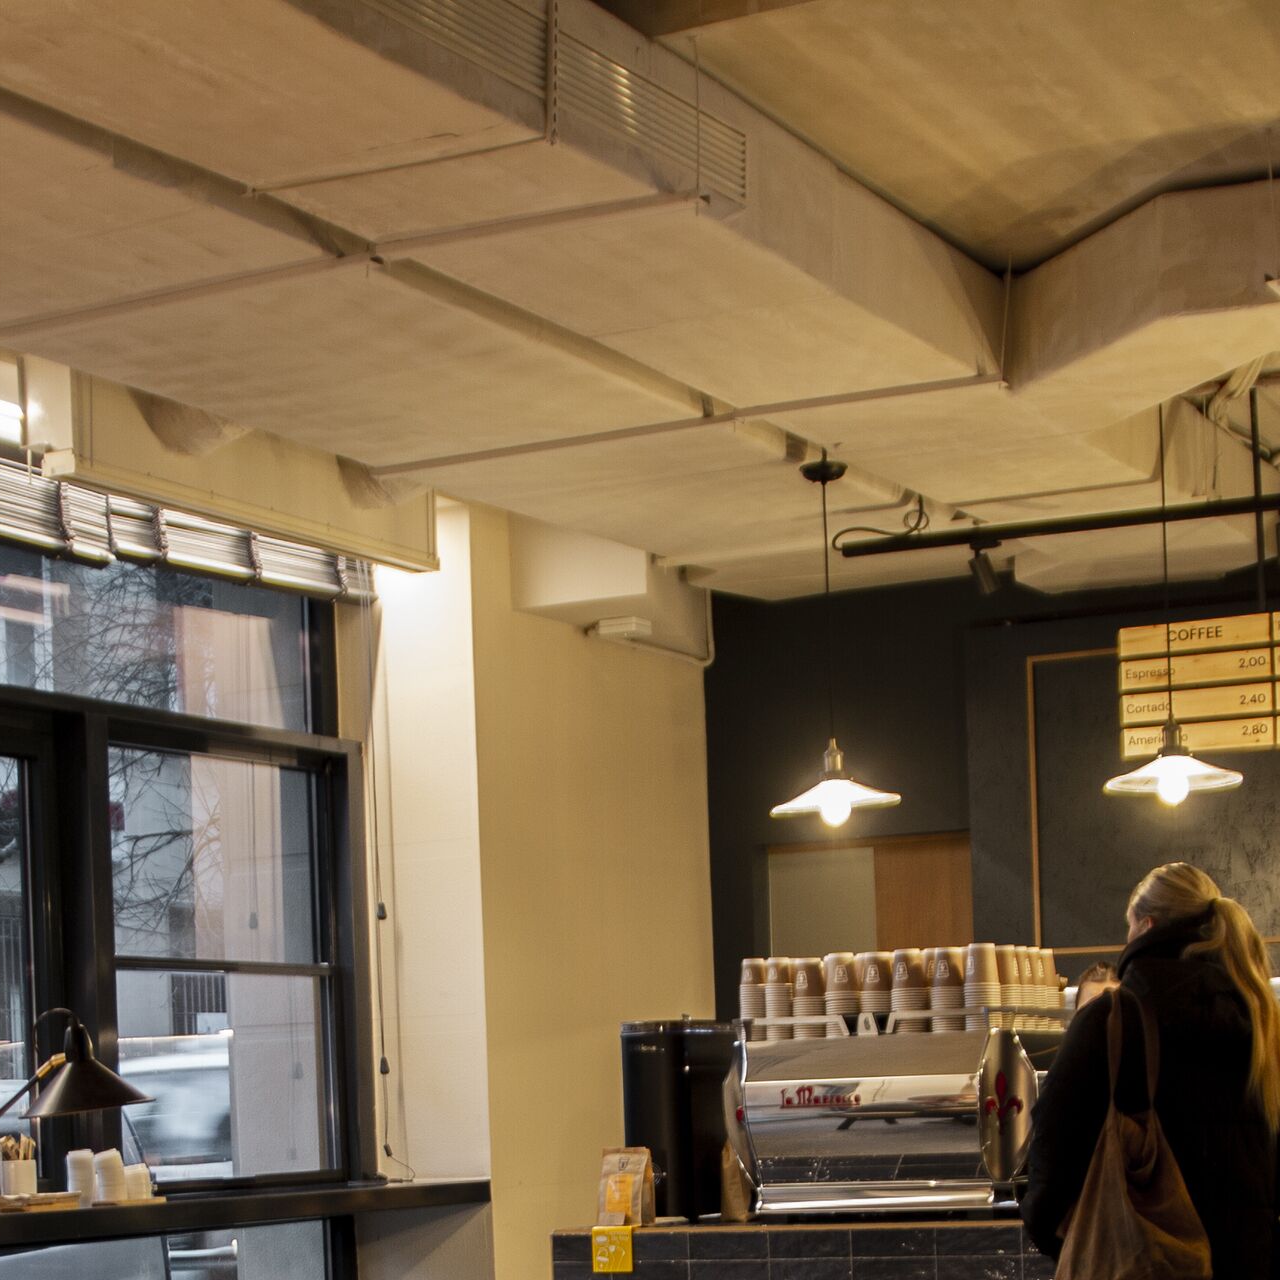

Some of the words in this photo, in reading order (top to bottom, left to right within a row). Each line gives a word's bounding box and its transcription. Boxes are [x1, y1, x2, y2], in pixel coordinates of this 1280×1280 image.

[1168, 625, 1223, 642] COFFEE
[1125, 667, 1176, 680] Espresso
[1239, 656, 1266, 669] 2,00
[1126, 701, 1171, 714] Cortado
[1240, 693, 1266, 705] 2,40
[1128, 734, 1188, 746] Amerio
[1242, 723, 1268, 737] 2,80
